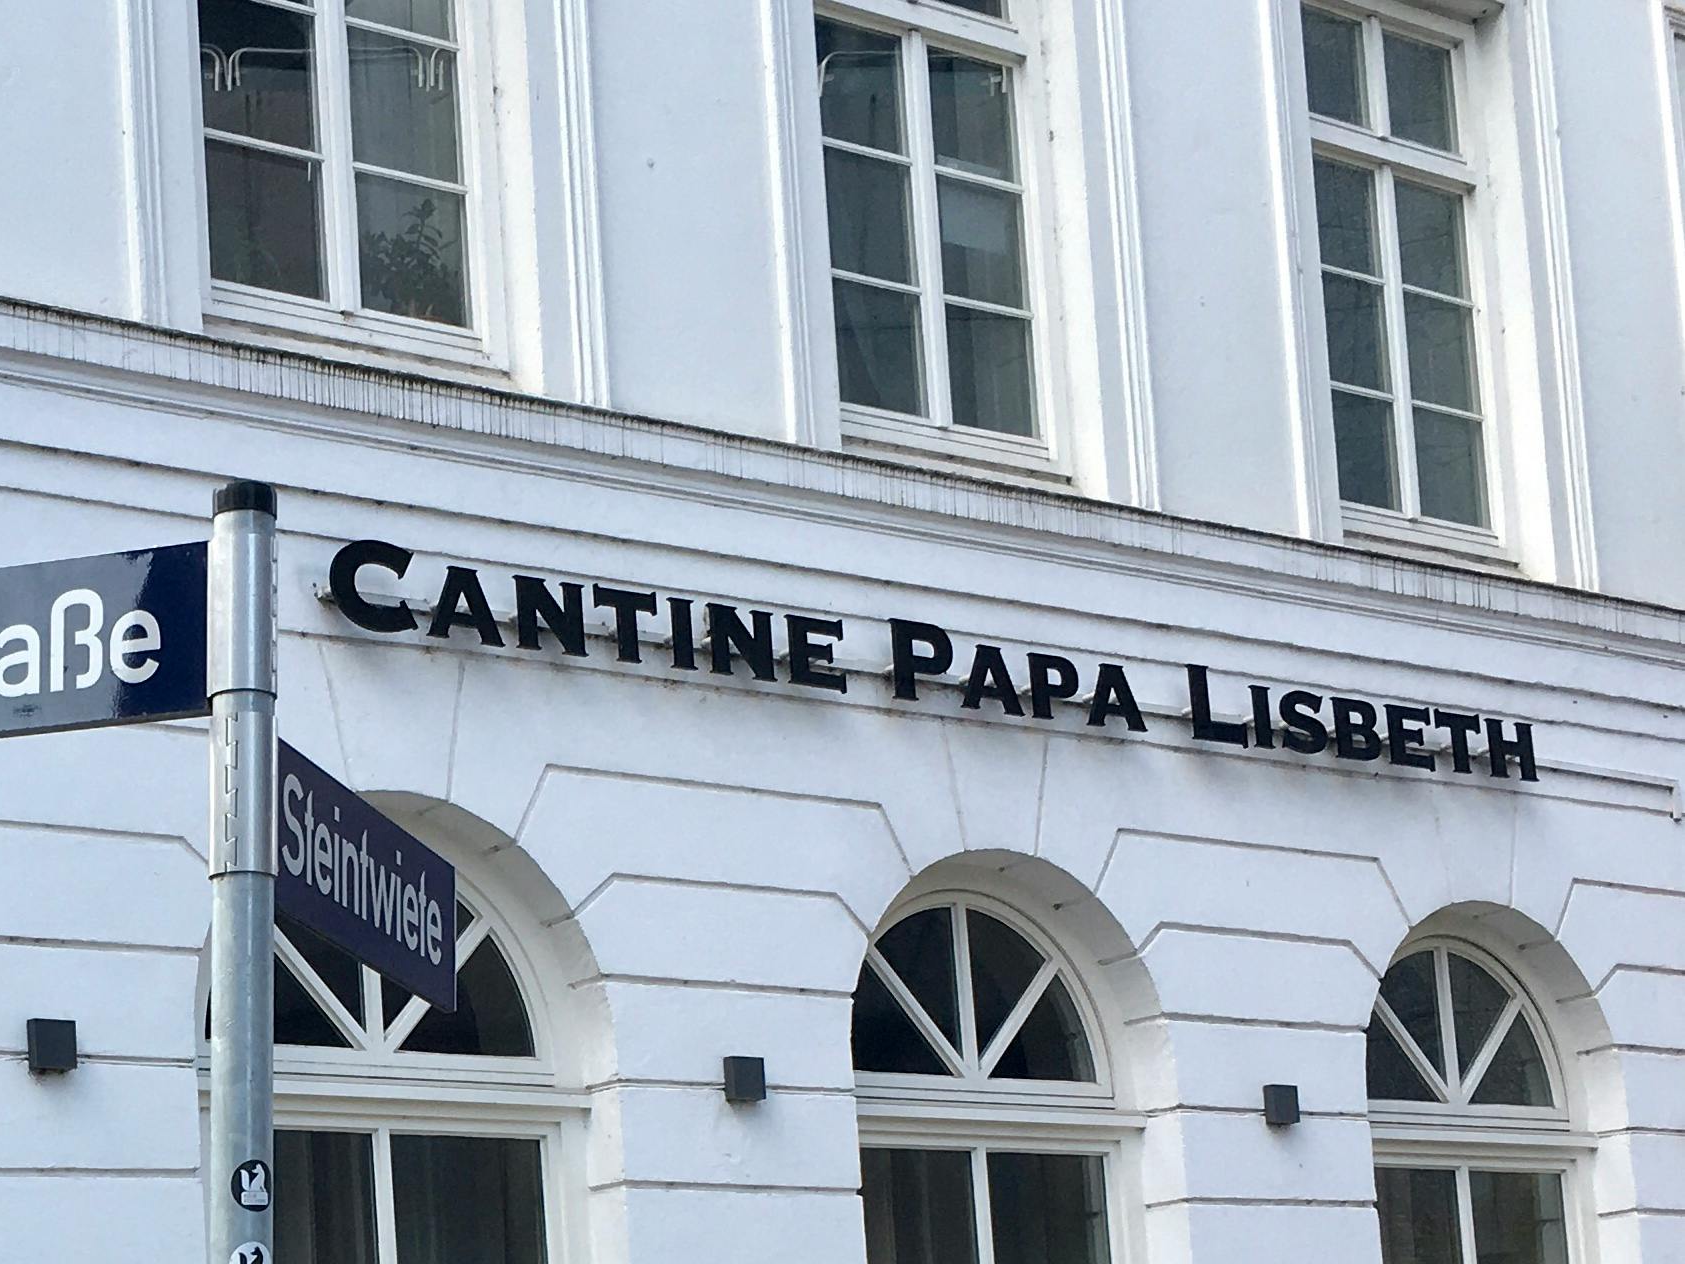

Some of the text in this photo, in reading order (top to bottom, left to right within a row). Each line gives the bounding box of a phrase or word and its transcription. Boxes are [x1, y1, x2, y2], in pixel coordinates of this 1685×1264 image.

[328, 538, 1540, 782] CANTINE PAPA LISBETH
[281, 773, 443, 966] Steintwiete
